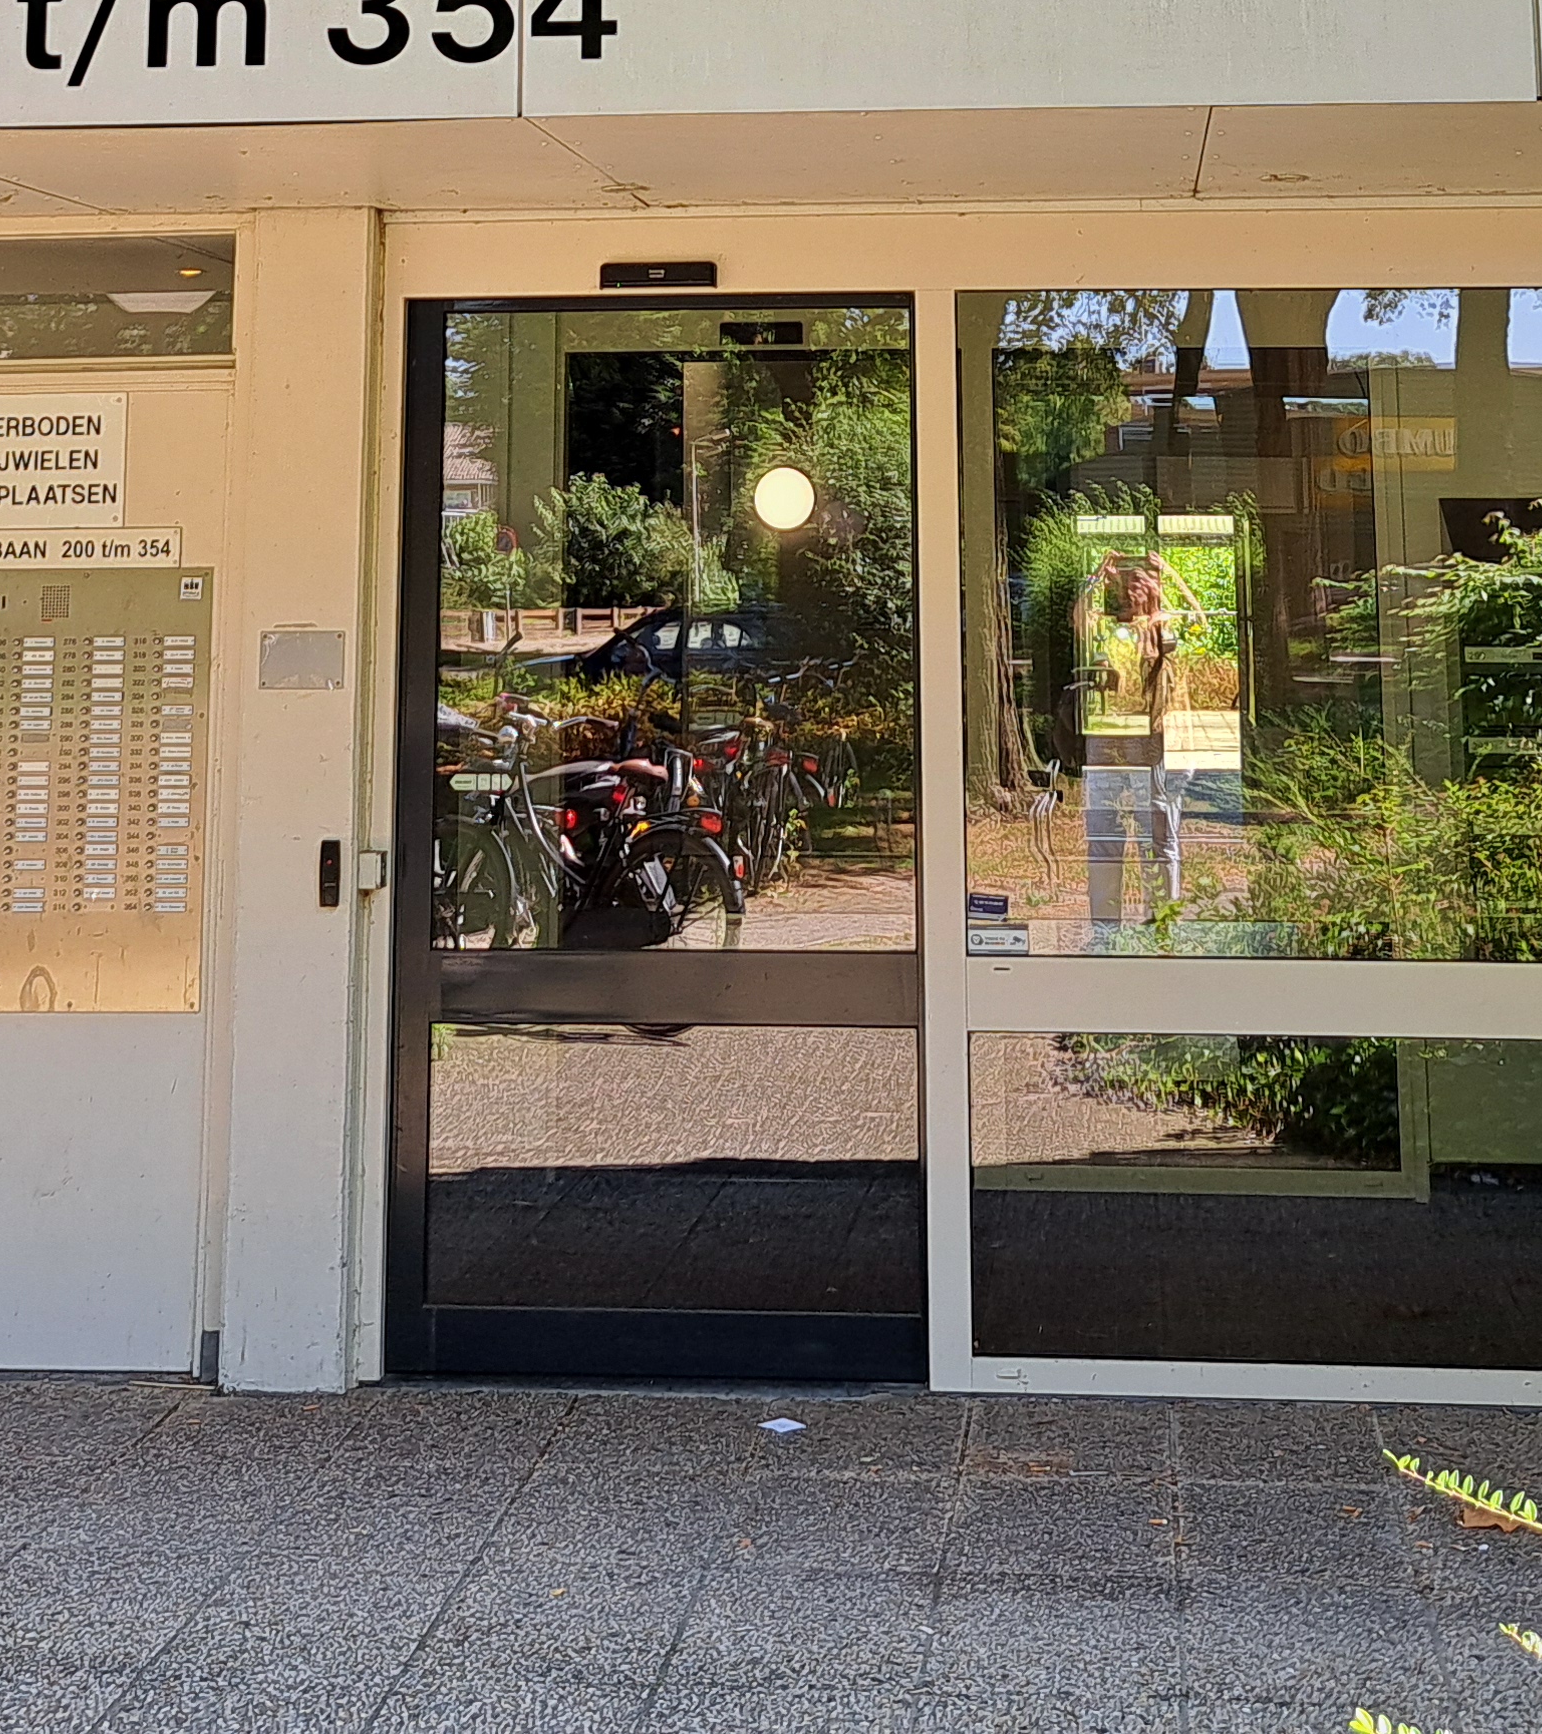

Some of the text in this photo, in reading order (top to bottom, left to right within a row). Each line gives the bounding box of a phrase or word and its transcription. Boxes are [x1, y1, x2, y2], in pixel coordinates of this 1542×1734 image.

[61, 539, 95, 558] 200
[101, 539, 131, 558] t/m
[137, 538, 172, 557] 354
